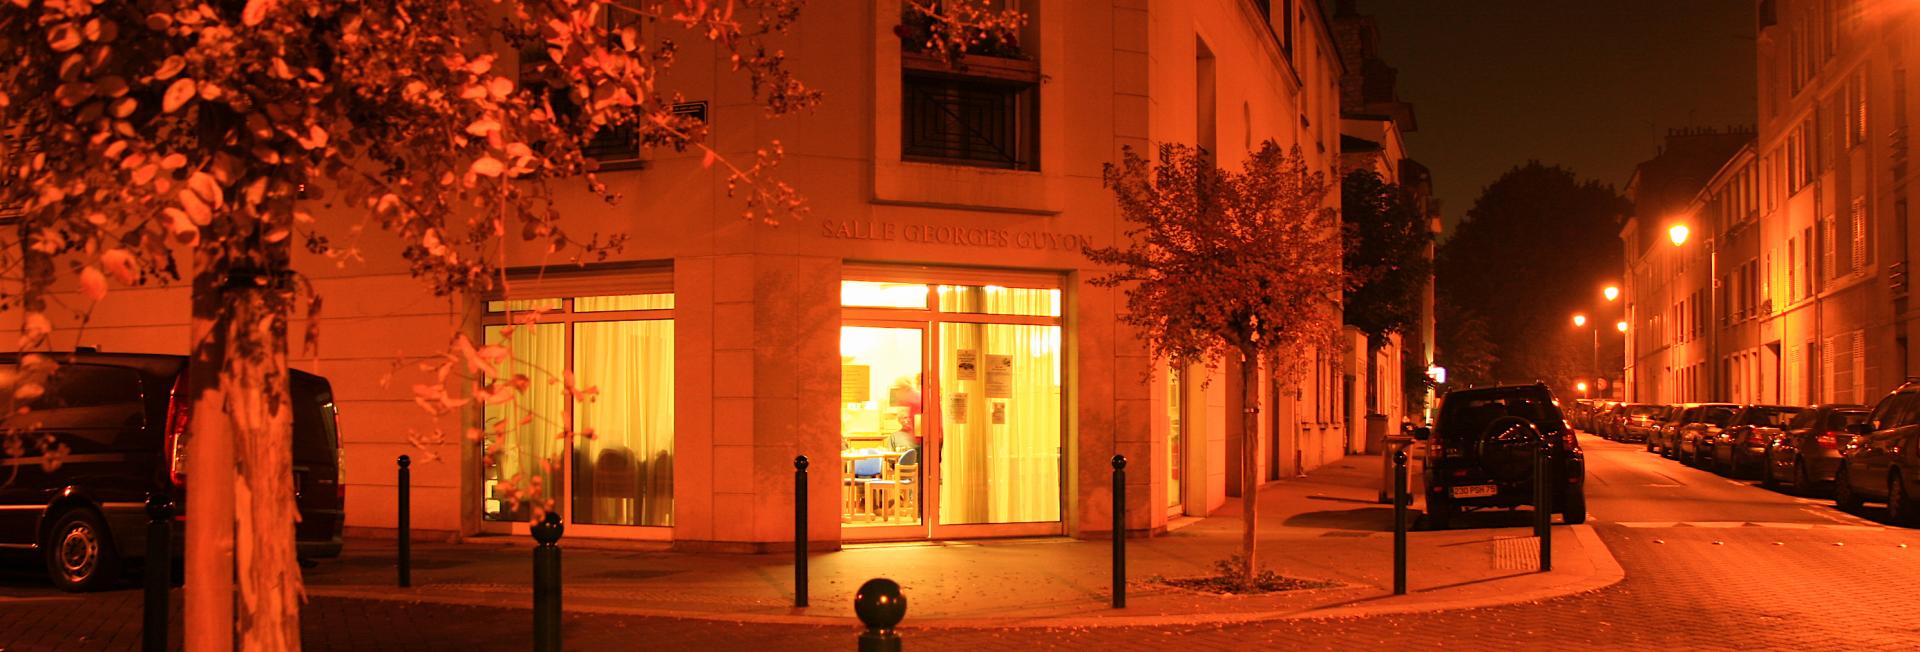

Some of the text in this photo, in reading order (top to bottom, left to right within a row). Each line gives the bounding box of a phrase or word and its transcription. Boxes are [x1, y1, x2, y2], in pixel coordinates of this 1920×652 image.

[822, 219, 1093, 251] SALLE GEORGES GUYON
